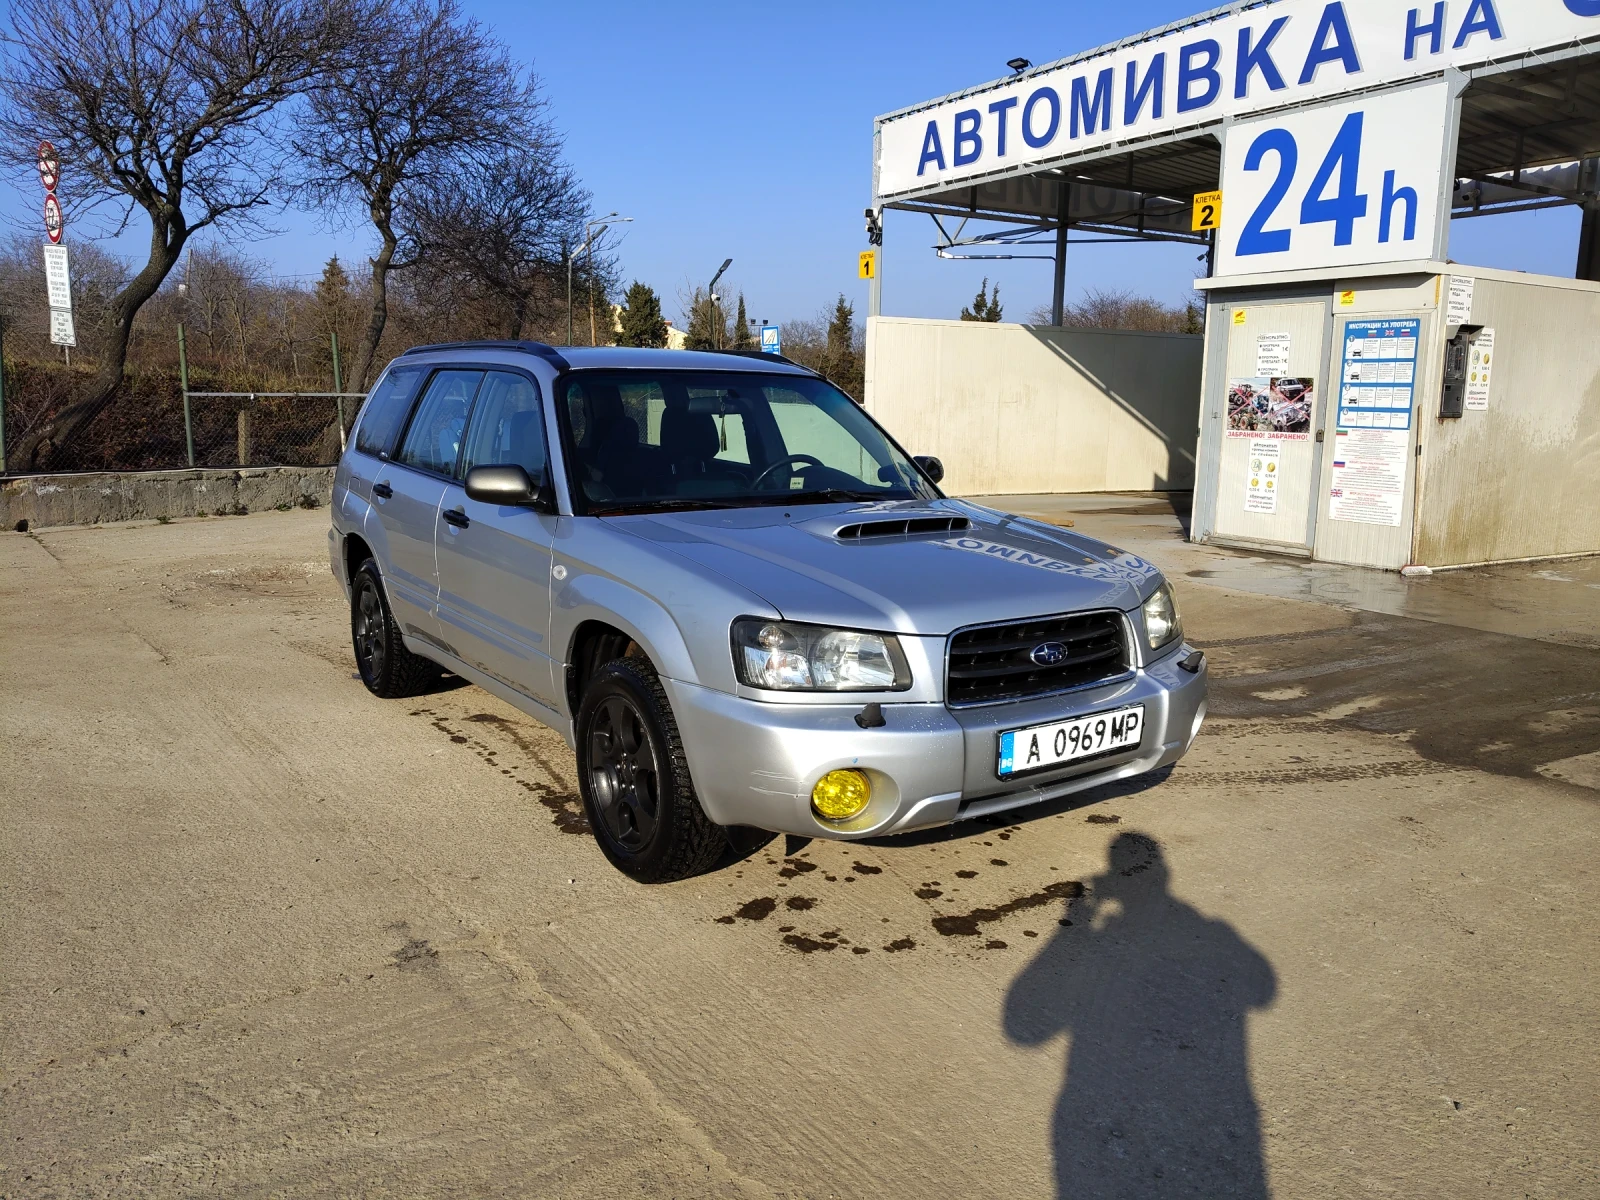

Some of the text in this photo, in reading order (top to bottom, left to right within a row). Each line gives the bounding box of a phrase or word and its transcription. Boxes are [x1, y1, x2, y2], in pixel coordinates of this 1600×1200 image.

[917, 1, 1362, 177] АВТОМИВКА
[1195, 194, 1221, 204] КЛЕТКА
[1200, 204, 1214, 227] 2
[864, 260, 870, 276] 1
[1348, 320, 1417, 330] ИНСТРУКЦИИ ЗА УПОТРЕБА
[1227, 431, 1308, 440] ЗАБРАНЕНО! ЗАБРАНЕНО!
[1054, 719, 1107, 758] 0969
